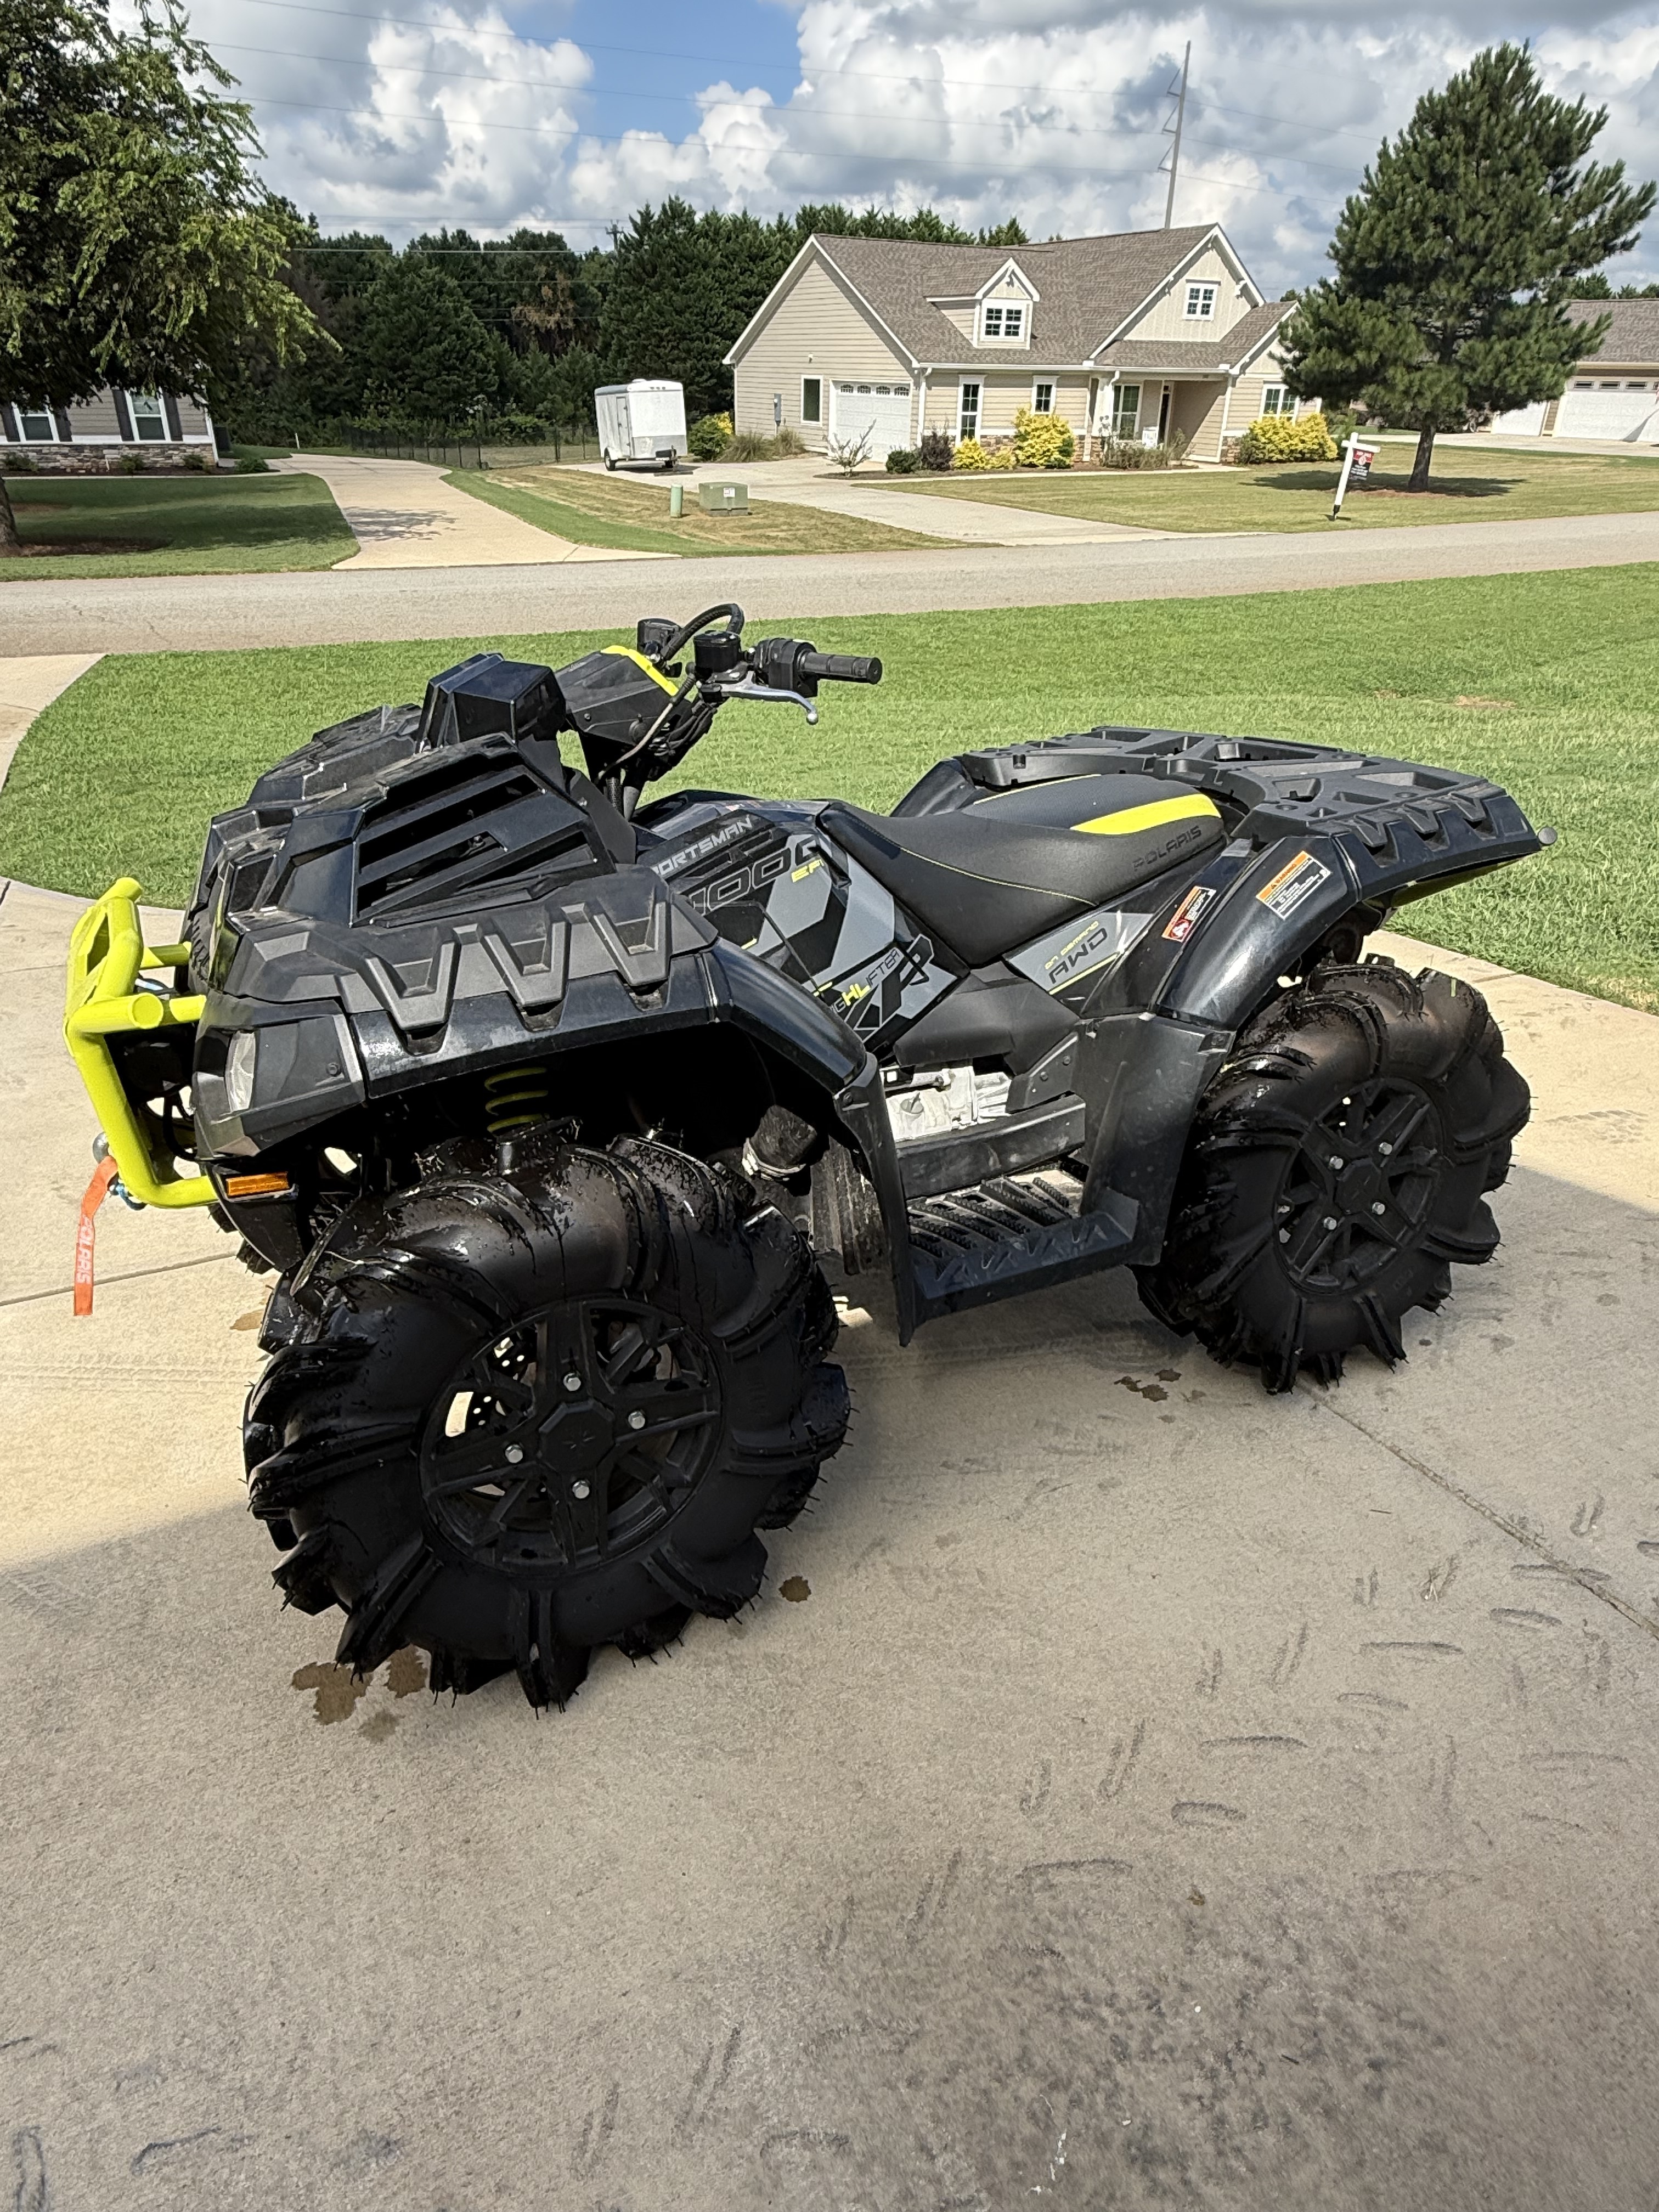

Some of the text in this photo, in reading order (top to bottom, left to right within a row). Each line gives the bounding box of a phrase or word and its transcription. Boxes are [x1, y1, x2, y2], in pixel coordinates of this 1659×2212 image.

[650, 814, 753, 876] ORTSMAN
[1132, 825, 1202, 872] POLARIS
[1048, 927, 1108, 984] AWD
[76, 1216, 92, 1284] POLARIS
